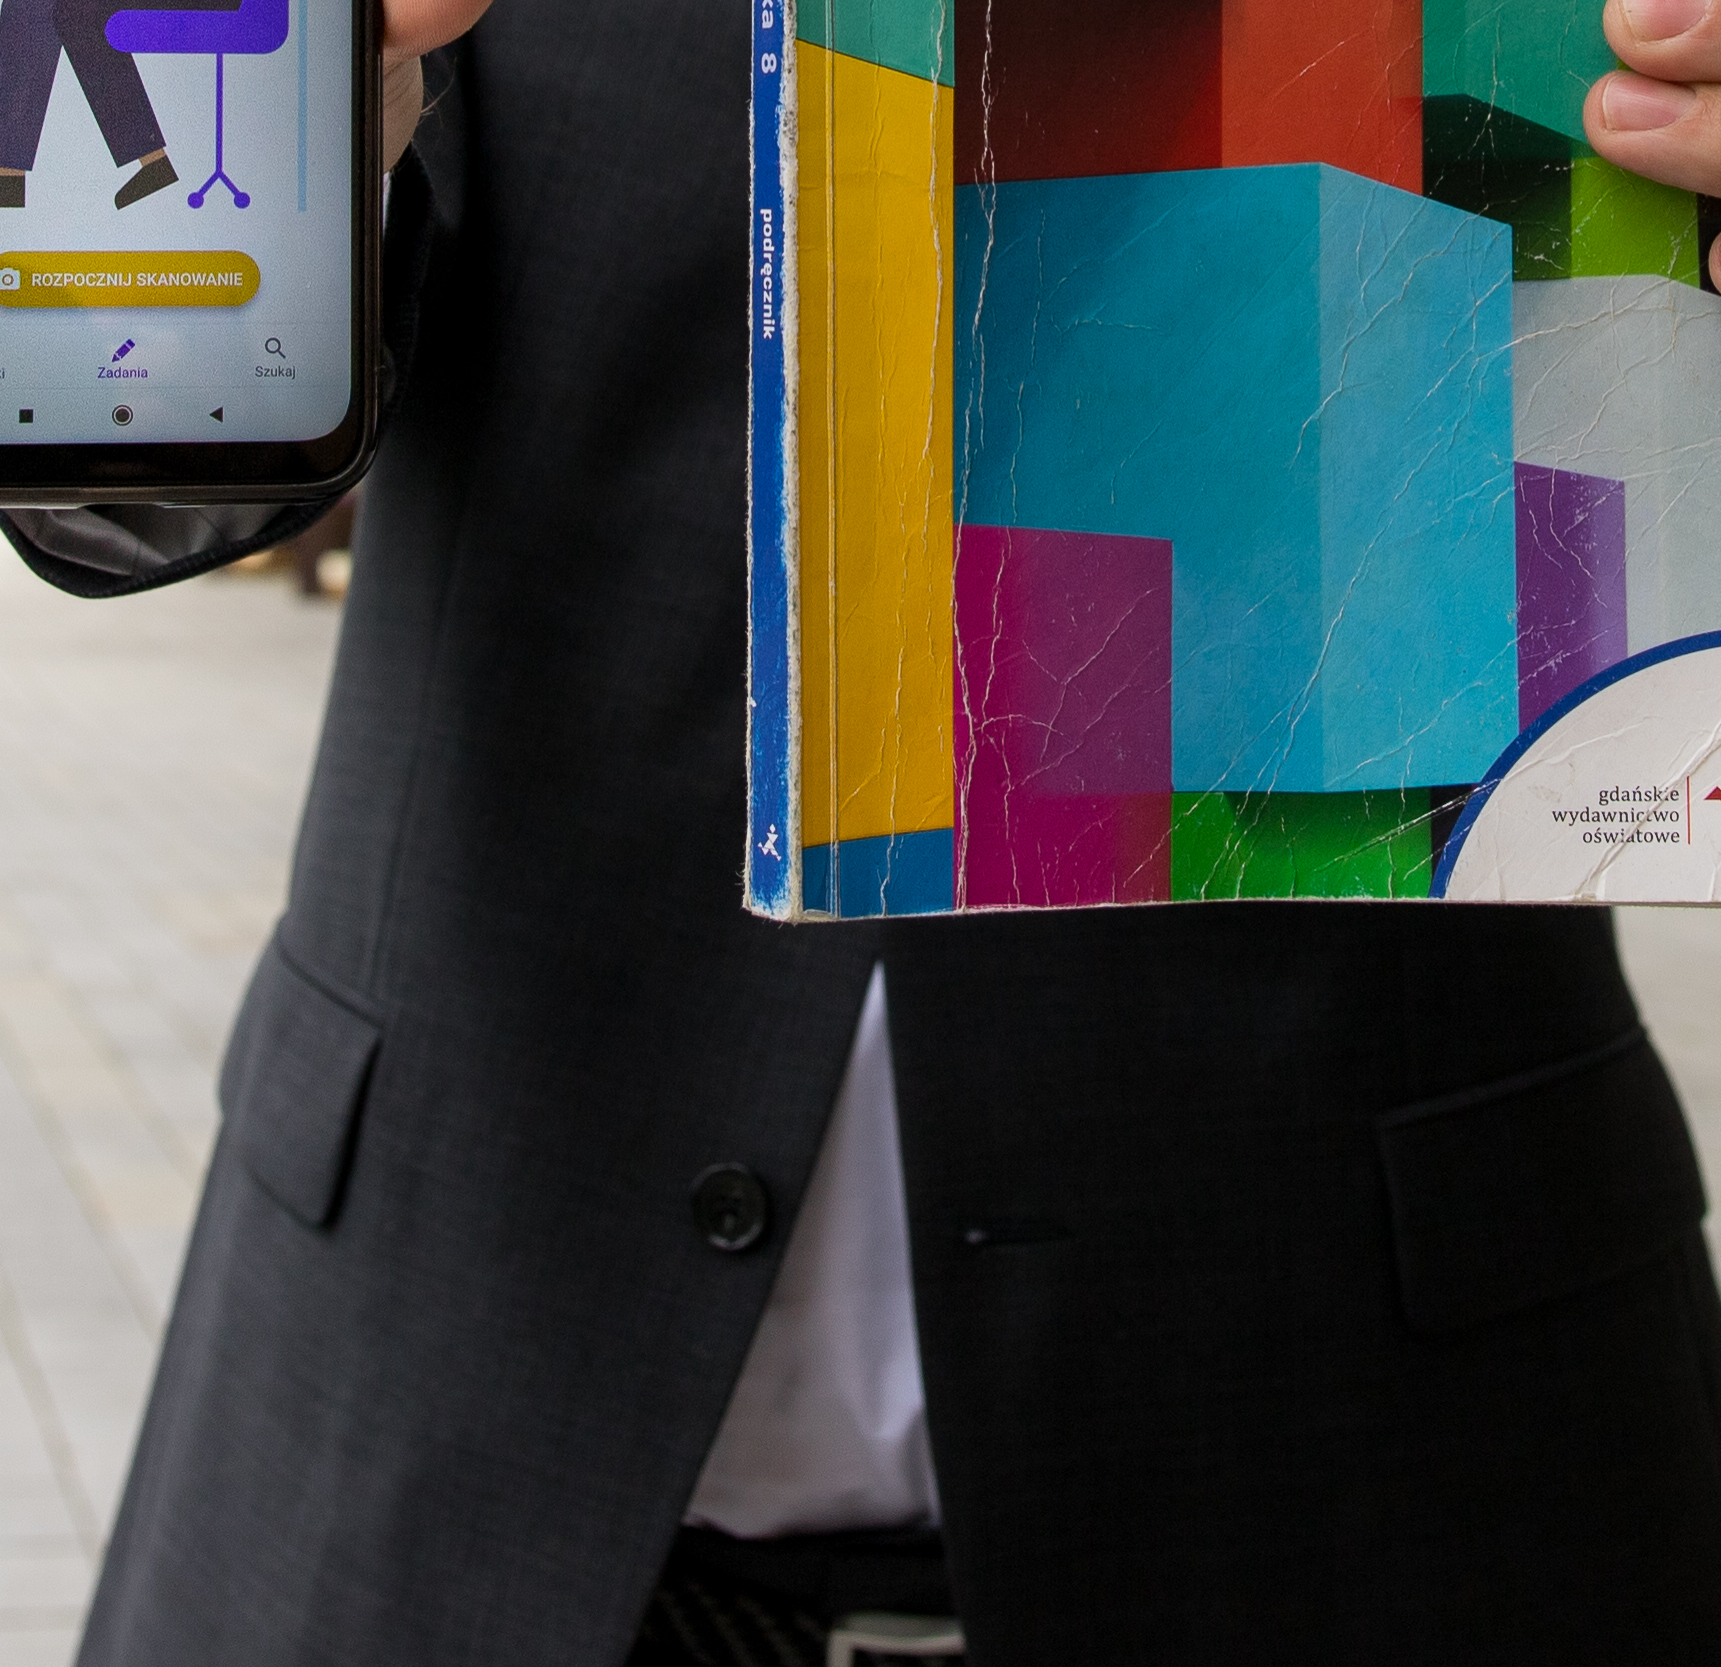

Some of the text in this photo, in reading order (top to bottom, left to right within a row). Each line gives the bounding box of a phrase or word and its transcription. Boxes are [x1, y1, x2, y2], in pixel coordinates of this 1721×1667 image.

[761, 52, 777, 74] 8
[31, 272, 243, 288] ROZPOCZNIJ SKANOWANIE
[759, 208, 776, 340] podręcznik
[97, 366, 149, 379] Zadania
[254, 365, 296, 380] Szukaj
[1598, 786, 1680, 806] gdańskie
[1551, 806, 1680, 827] wydawnictwo
[1582, 827, 1680, 844] oświatowe
